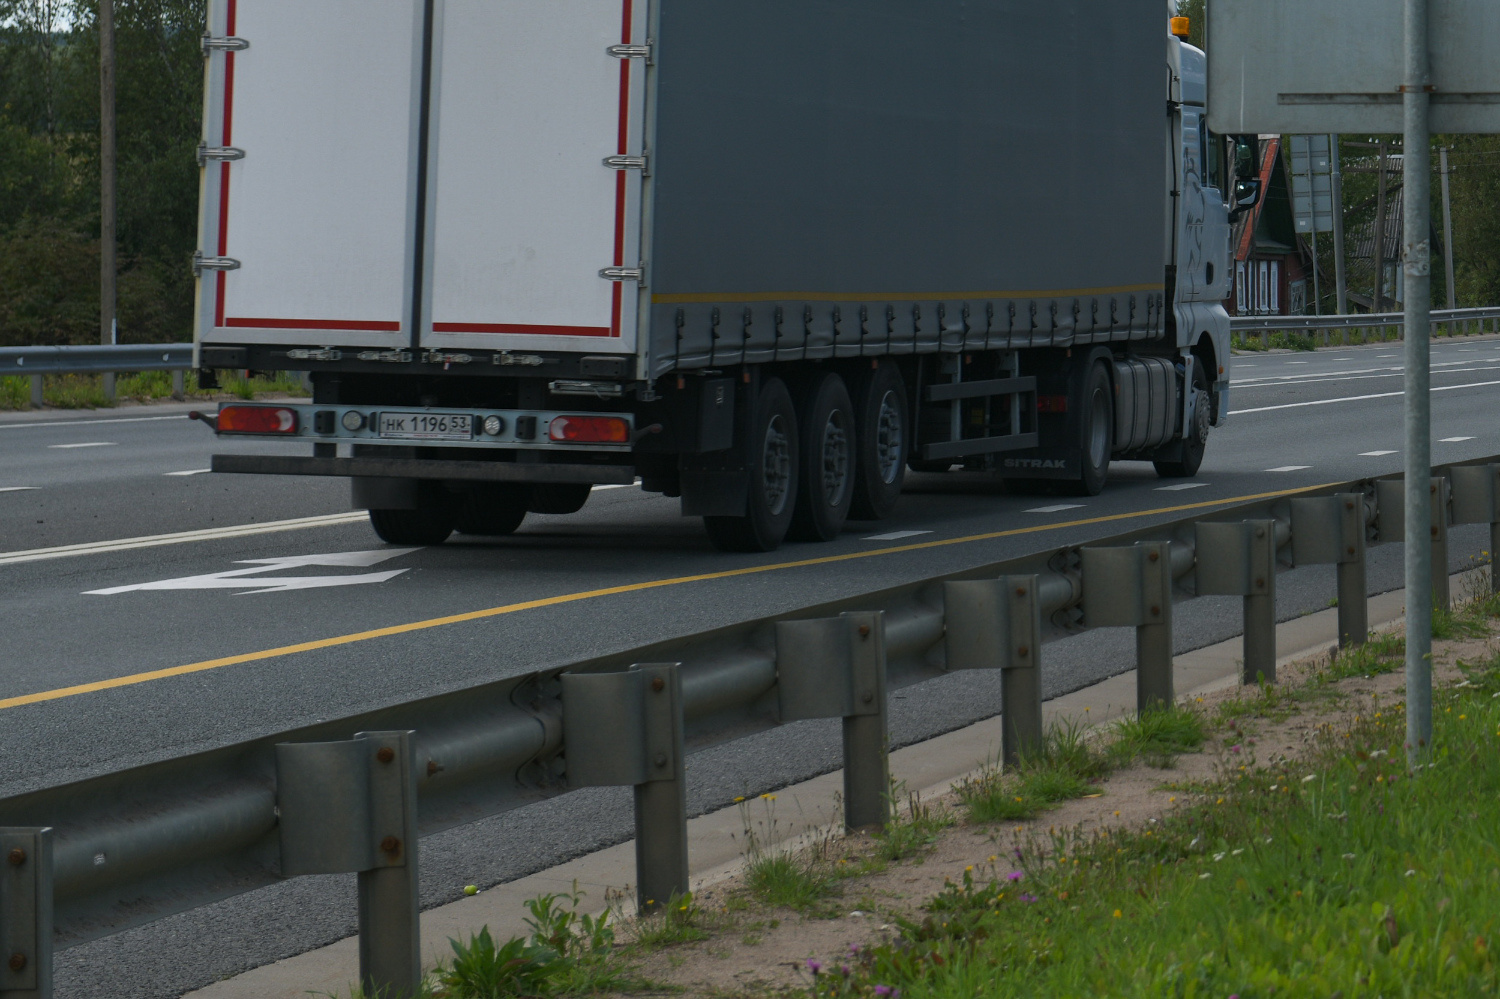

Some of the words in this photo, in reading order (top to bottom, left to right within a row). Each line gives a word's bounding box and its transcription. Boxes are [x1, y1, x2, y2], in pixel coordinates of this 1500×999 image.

[411, 416, 447, 431] 1196
[452, 416, 466, 428] 53
[1004, 458, 1066, 468] SITRAK
